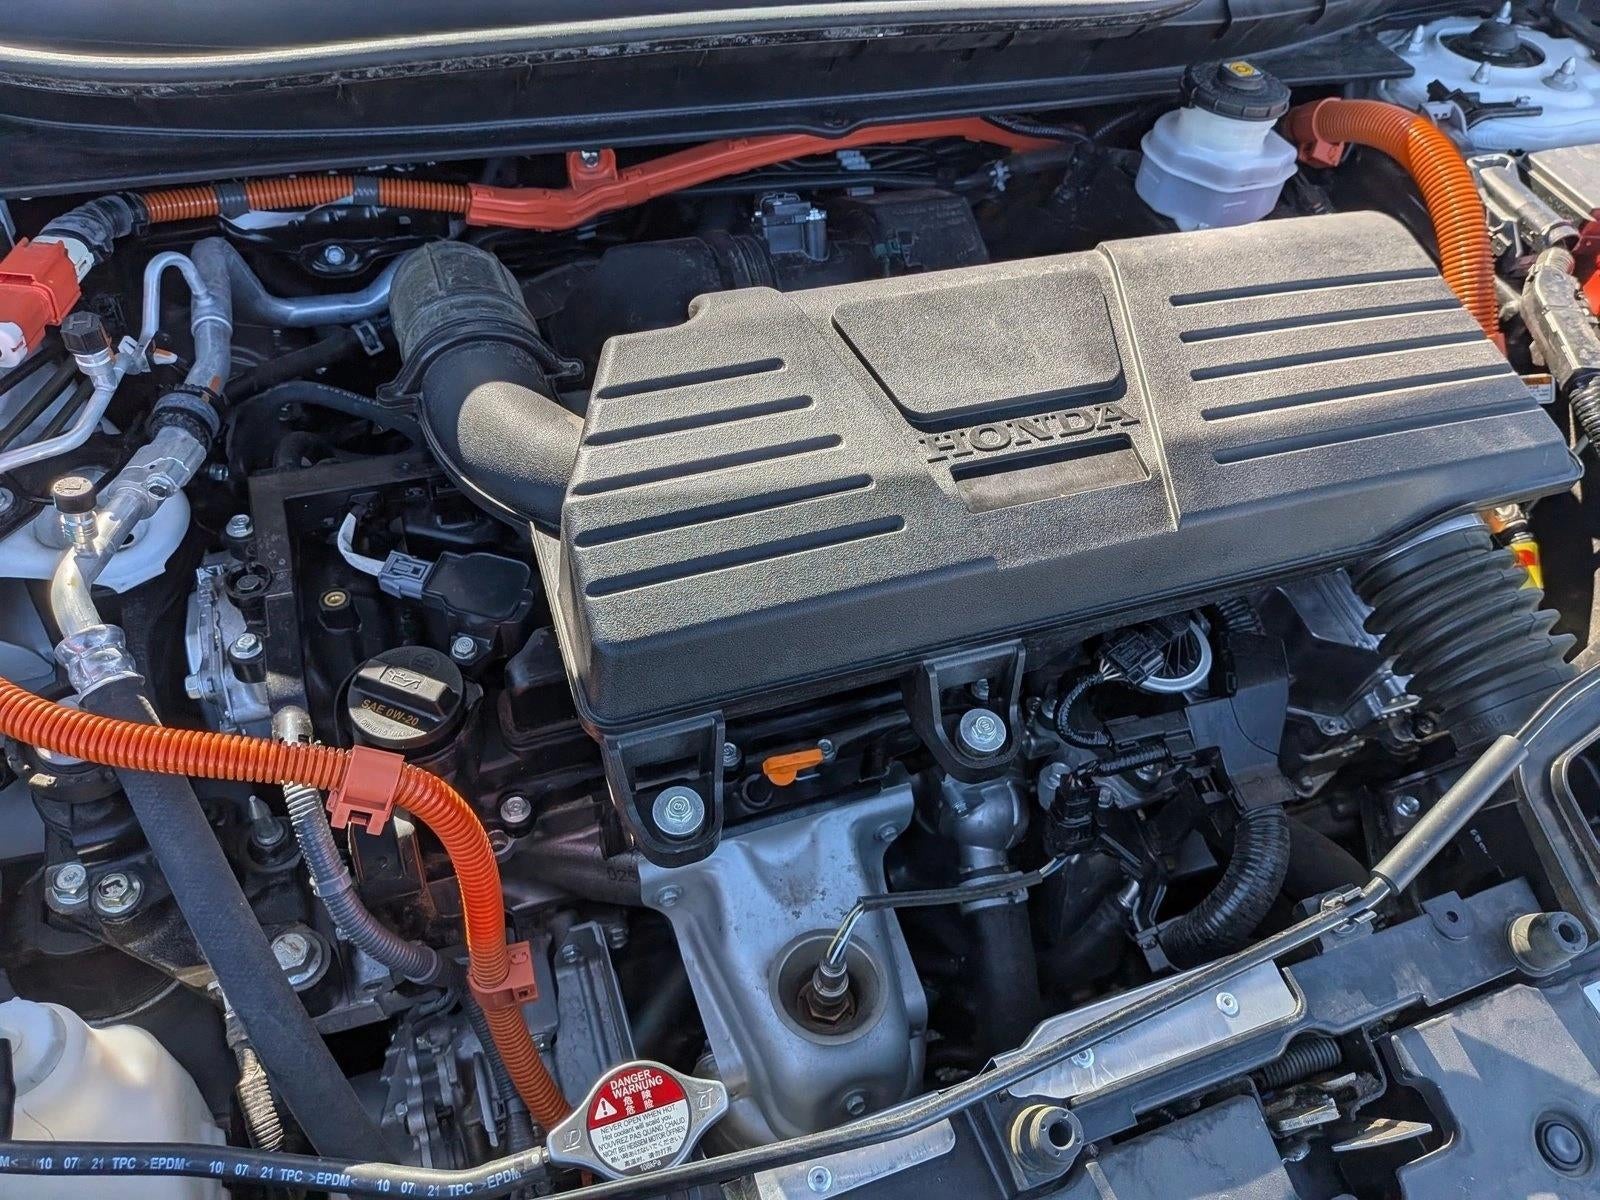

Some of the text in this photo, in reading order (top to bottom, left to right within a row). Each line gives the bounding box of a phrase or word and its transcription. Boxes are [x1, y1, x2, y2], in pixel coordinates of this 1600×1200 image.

[919, 403, 1140, 463] HONDA
[361, 699, 420, 727] SAE 0W-20
[610, 1069, 652, 1090] DANGER
[612, 1075, 663, 1099] WARNUNG
[600, 1122, 622, 1134] NEVER
[623, 1116, 642, 1126] OPEN
[642, 1109, 662, 1120] WHEN
[629, 1131, 642, 1142] PAS
[642, 1125, 664, 1137] QUAND
[602, 1133, 613, 1141] Hot
[63, 1157, 79, 1169] 07
[91, 1157, 105, 1169] 21
[112, 1157, 137, 1170] TPC
[235, 1164, 249, 1176] 07
[260, 1167, 274, 1179] 21
[280, 1168, 303, 1182] TPC
[401, 1181, 416, 1195] 07
[428, 1184, 440, 1197] 21
[448, 1182, 474, 1197] TPC
